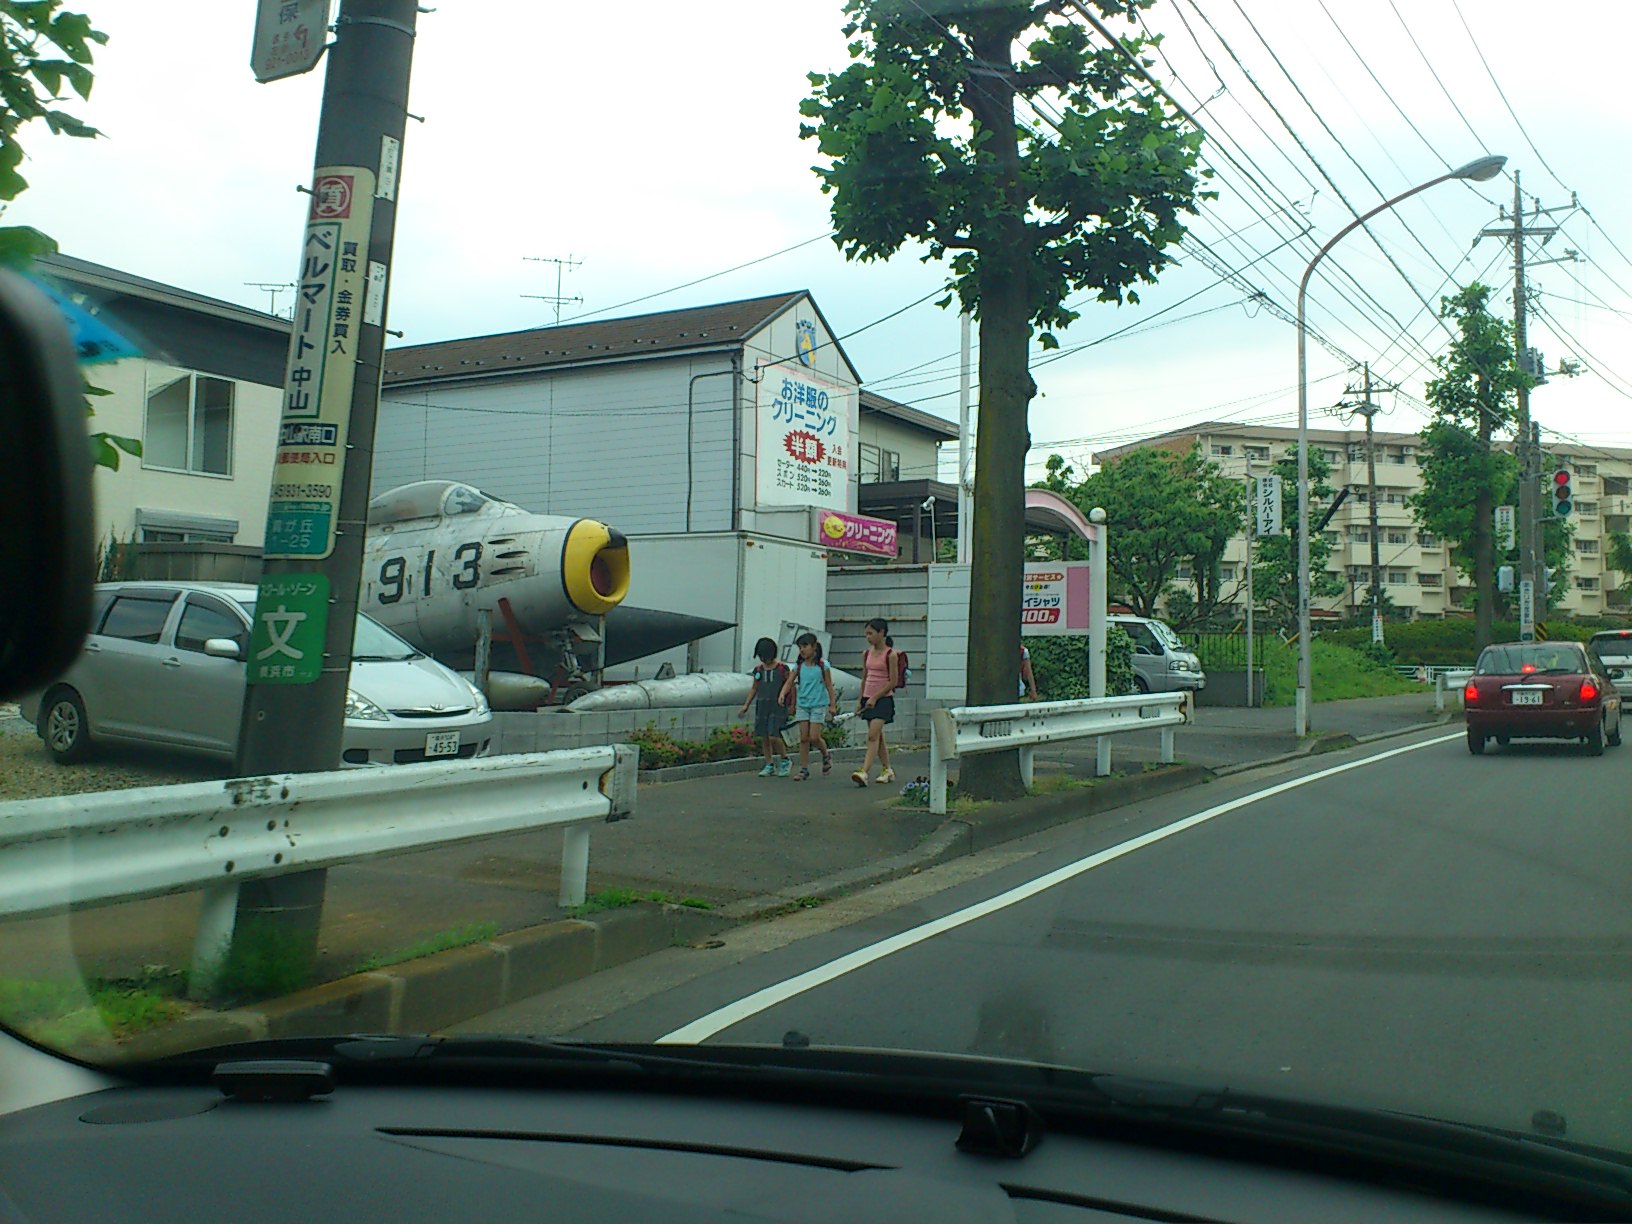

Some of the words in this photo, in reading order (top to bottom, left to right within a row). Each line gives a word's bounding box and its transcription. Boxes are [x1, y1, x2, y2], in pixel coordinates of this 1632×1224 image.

[289, 232, 333, 411] ベルマート中山
[782, 378, 829, 411] お洋服の
[772, 398, 837, 436] クリーニング
[791, 435, 818, 459] 半額
[846, 521, 896, 545] クリーニング
[1262, 489, 1274, 535] シルバーアイ
[378, 542, 484, 605] 913
[256, 605, 307, 660] 文
